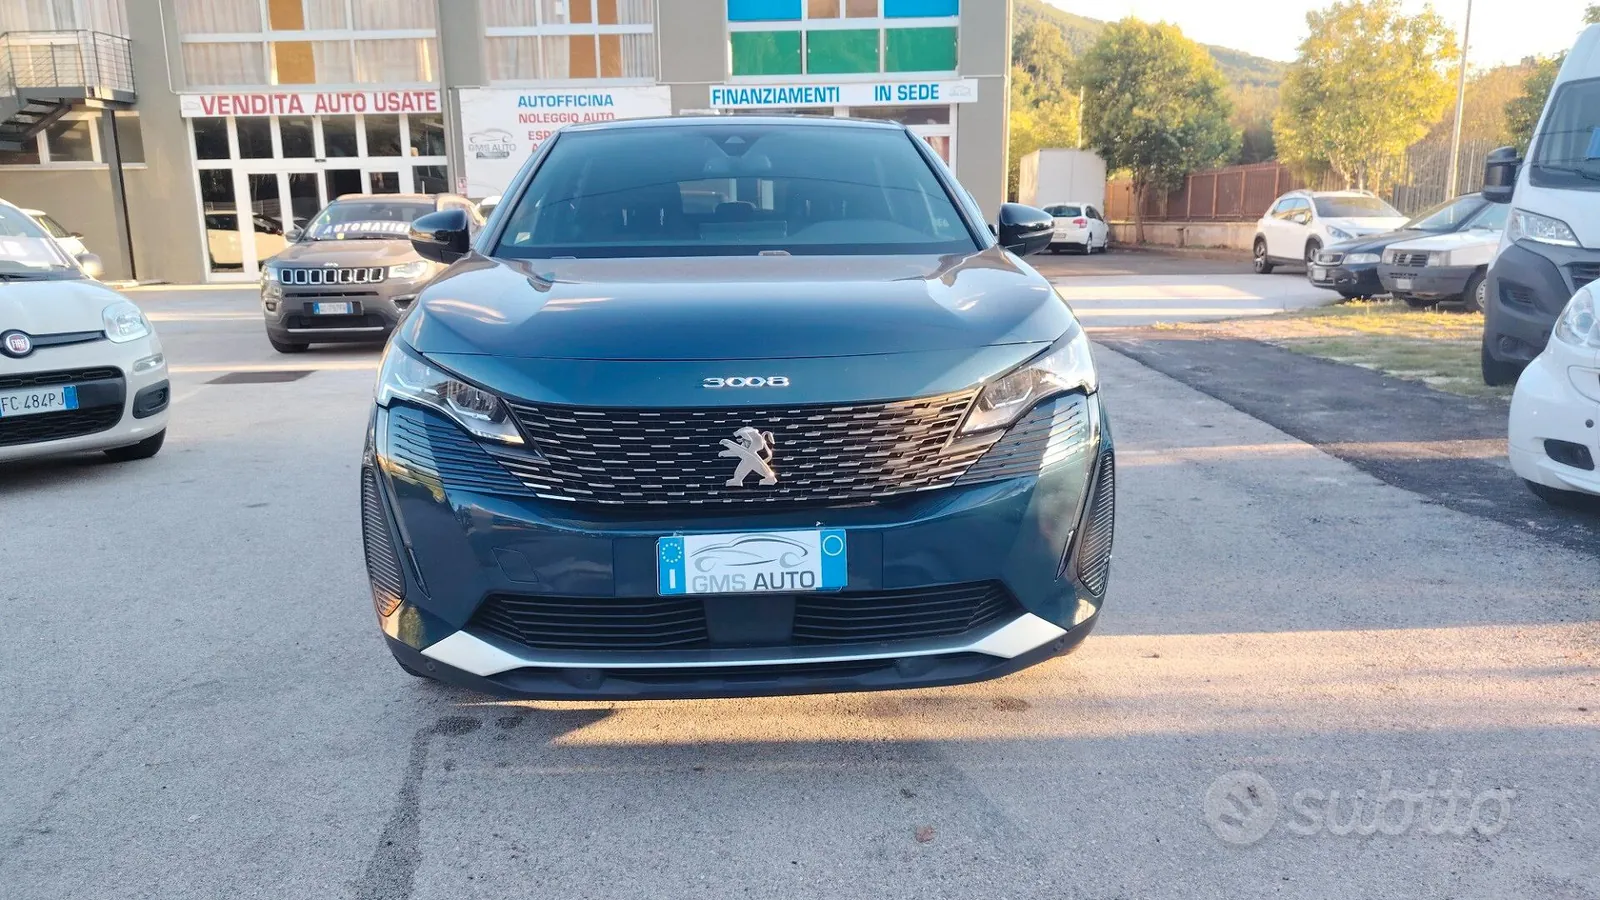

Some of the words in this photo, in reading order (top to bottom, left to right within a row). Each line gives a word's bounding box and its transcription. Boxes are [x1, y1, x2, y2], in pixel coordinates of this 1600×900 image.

[200, 93, 304, 115] VENDITA
[314, 92, 366, 113] AUTO
[374, 91, 437, 112] USATE
[517, 94, 614, 108] AUTOFFICINA
[712, 86, 840, 105] FINANZIAMENTI
[874, 85, 892, 101] IN
[897, 84, 940, 101] SEDE
[518, 113, 579, 124] NOLEGGIO
[583, 112, 615, 122] AUTO
[491, 143, 517, 152] AUTO
[702, 376, 790, 388] 3008
[1, 396, 19, 412] FC
[24, 392, 65, 409] 484PJ
[692, 573, 747, 593] GMS
[753, 570, 815, 591] AUTO
